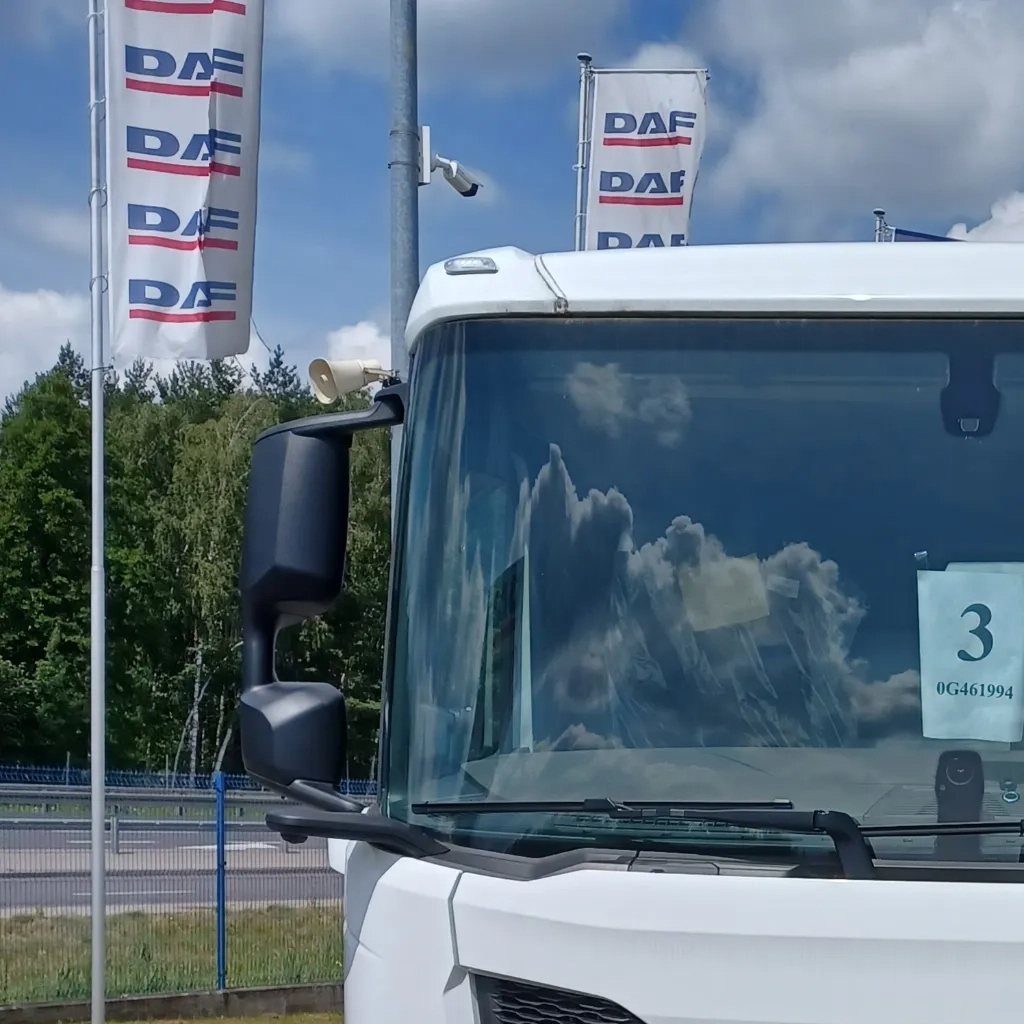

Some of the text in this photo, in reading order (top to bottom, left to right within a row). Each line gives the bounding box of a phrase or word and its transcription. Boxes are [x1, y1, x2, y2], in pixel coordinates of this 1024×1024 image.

[125, 45, 244, 80] DAF
[604, 110, 697, 135] DAF
[126, 125, 241, 161] DAF
[128, 203, 239, 236] DAF
[128, 278, 237, 309] DAF
[957, 603, 994, 662] 3
[936, 681, 1014, 699] 0G461994
